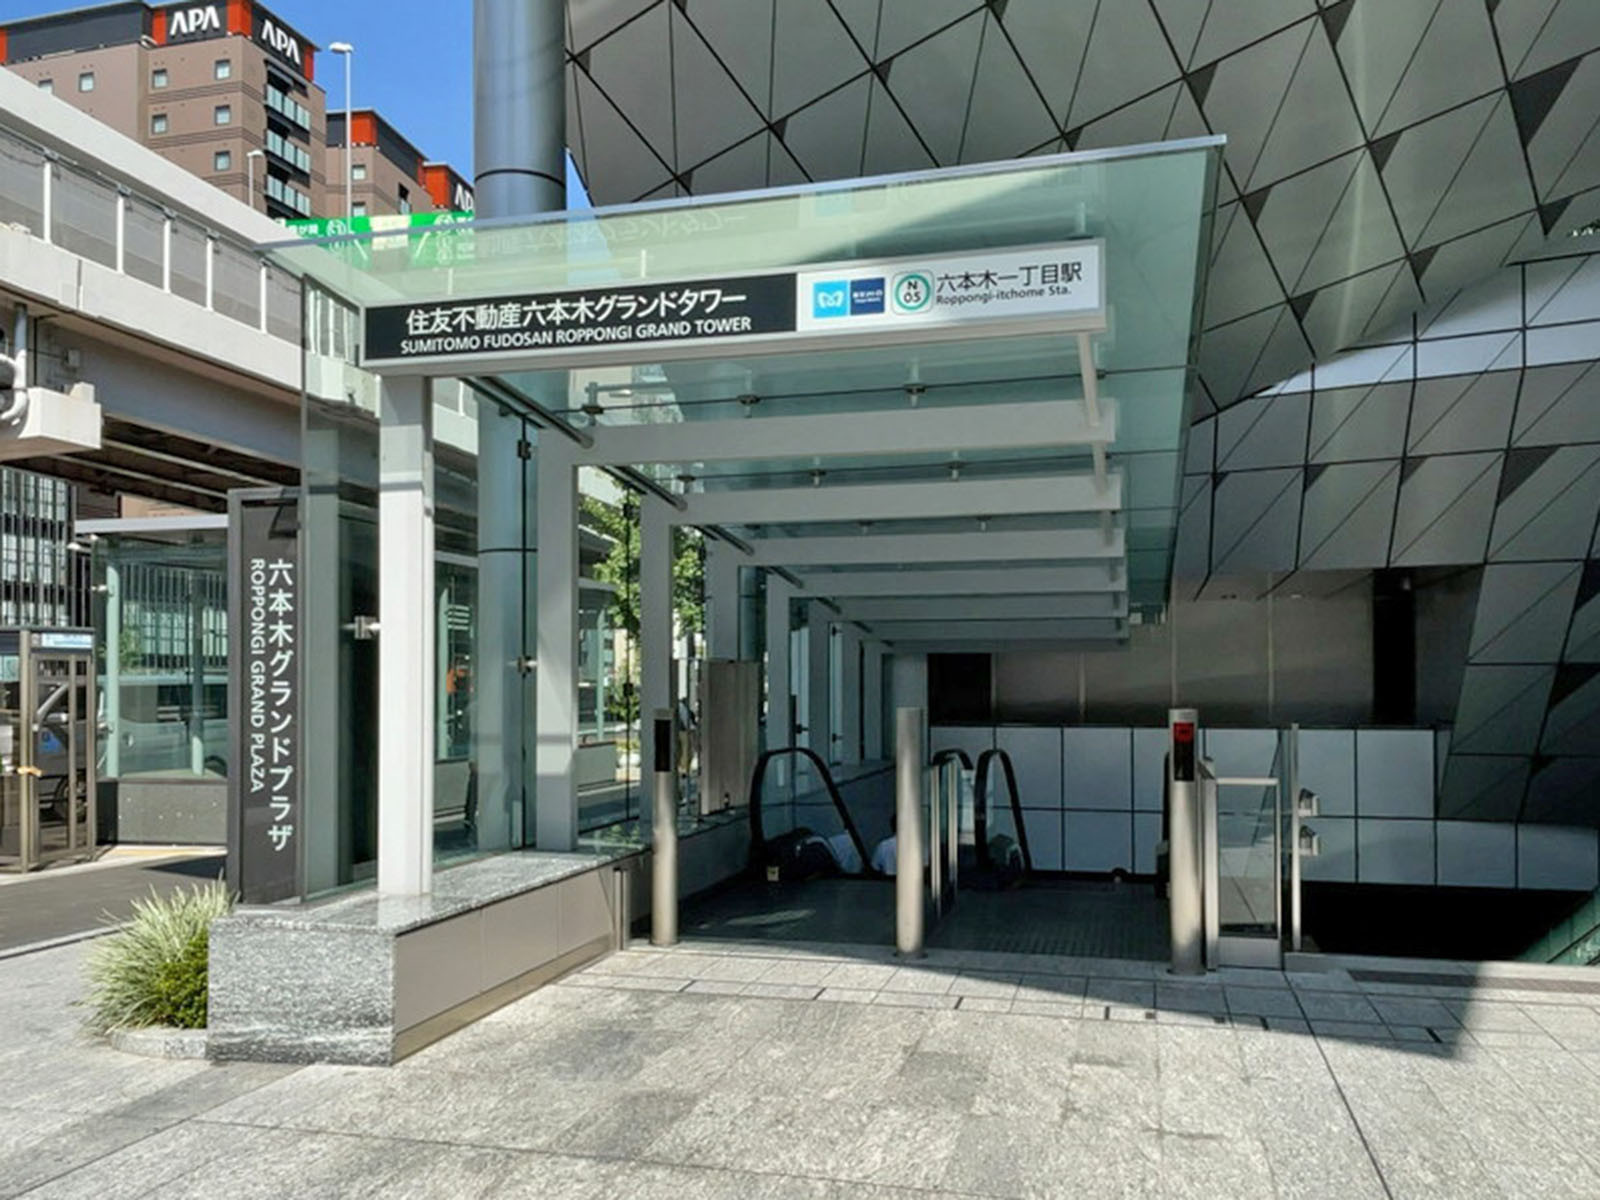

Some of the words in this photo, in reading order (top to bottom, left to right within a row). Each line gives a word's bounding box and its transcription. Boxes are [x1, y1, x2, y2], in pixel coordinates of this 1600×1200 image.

[170, 5, 220, 36] APA
[261, 19, 300, 65] APA
[454, 183, 474, 211] AP
[907, 281, 918, 290] N
[935, 288, 1045, 306] Roppongi-itchome
[1048, 284, 1072, 297] Sta.
[936, 261, 1083, 293] 六本木一丁目駅
[406, 289, 747, 336] 住友不動産六本木グランドタワー
[904, 292, 921, 303] 05
[401, 336, 481, 355] SUMITOMO
[484, 331, 553, 348] FUDOSAN
[555, 325, 633, 343] ROPPONGI
[636, 321, 692, 338] GRAND
[694, 316, 752, 334] TOWER
[250, 558, 266, 656] ROPPONGI
[250, 660, 266, 728] GRAND
[267, 558, 295, 852] 六本木グランドプラザ
[250, 733, 265, 793] PLAZA
